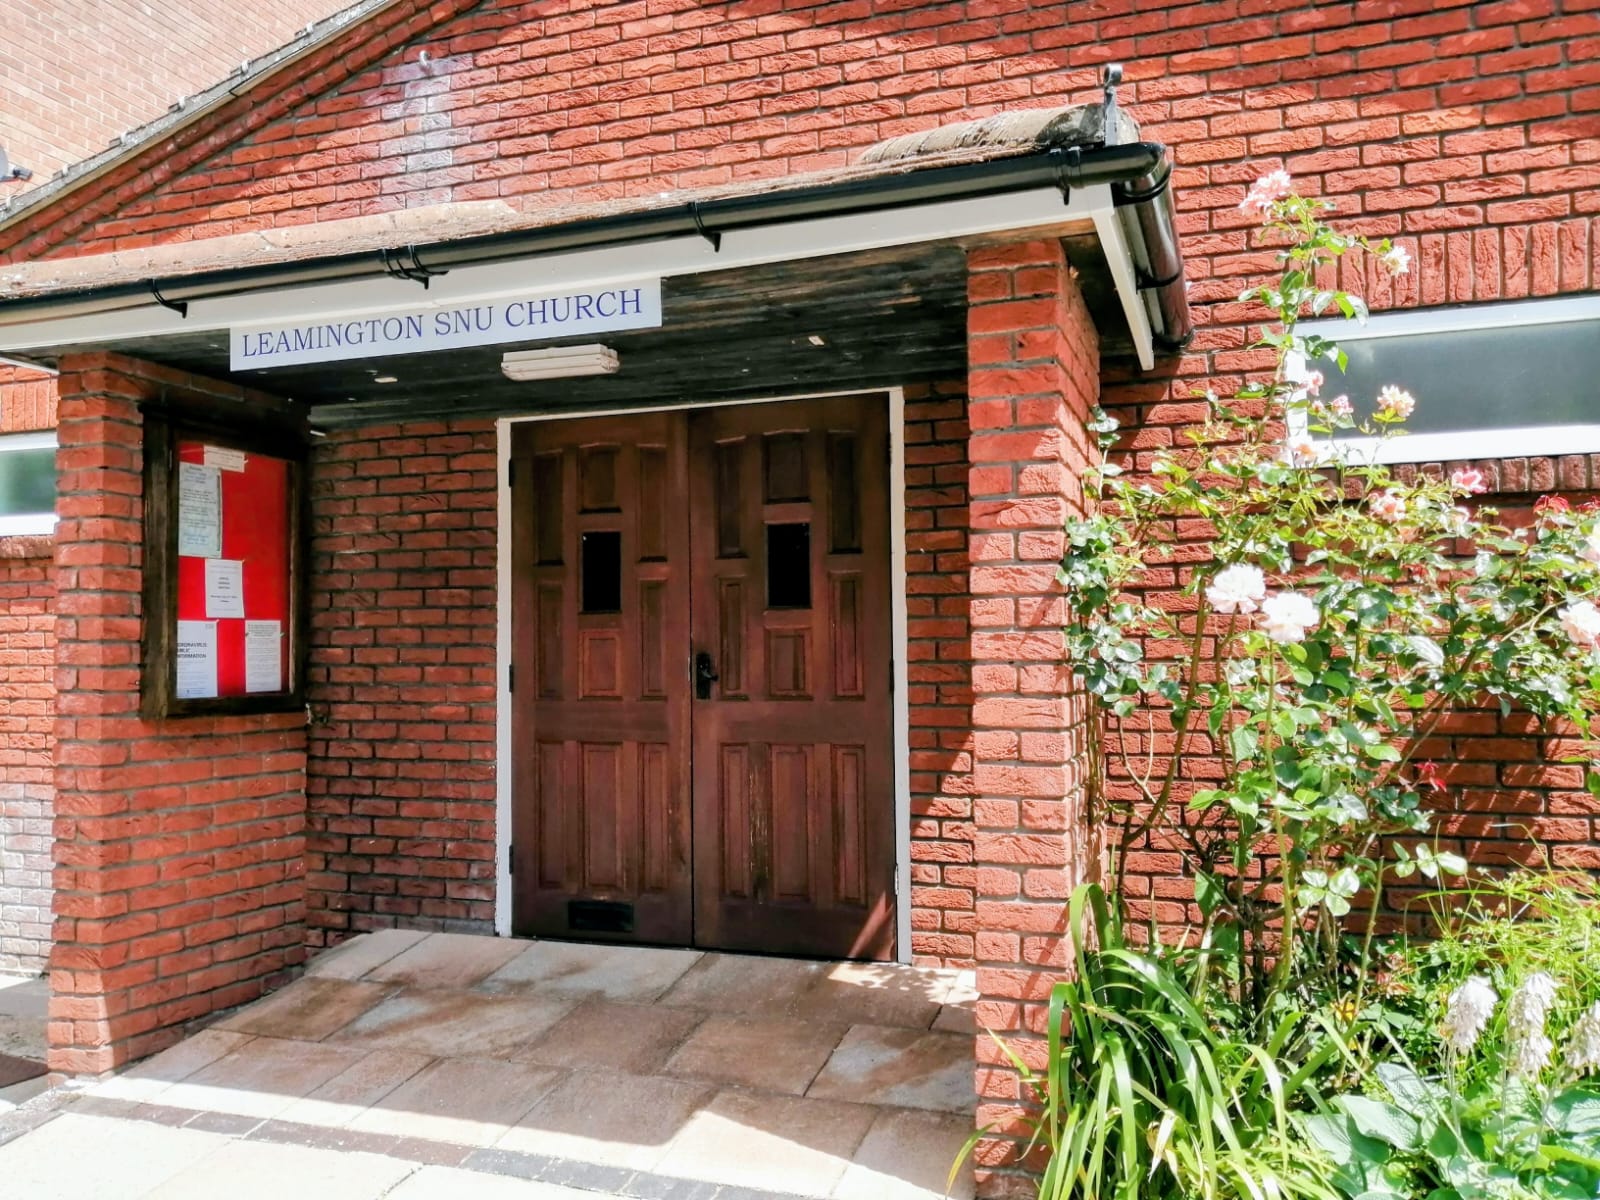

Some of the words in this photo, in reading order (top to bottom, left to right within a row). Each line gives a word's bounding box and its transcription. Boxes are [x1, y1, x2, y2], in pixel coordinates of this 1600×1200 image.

[243, 315, 423, 357] LEAMINGTON
[435, 306, 493, 336] SNU
[505, 288, 642, 326] CHURCH
